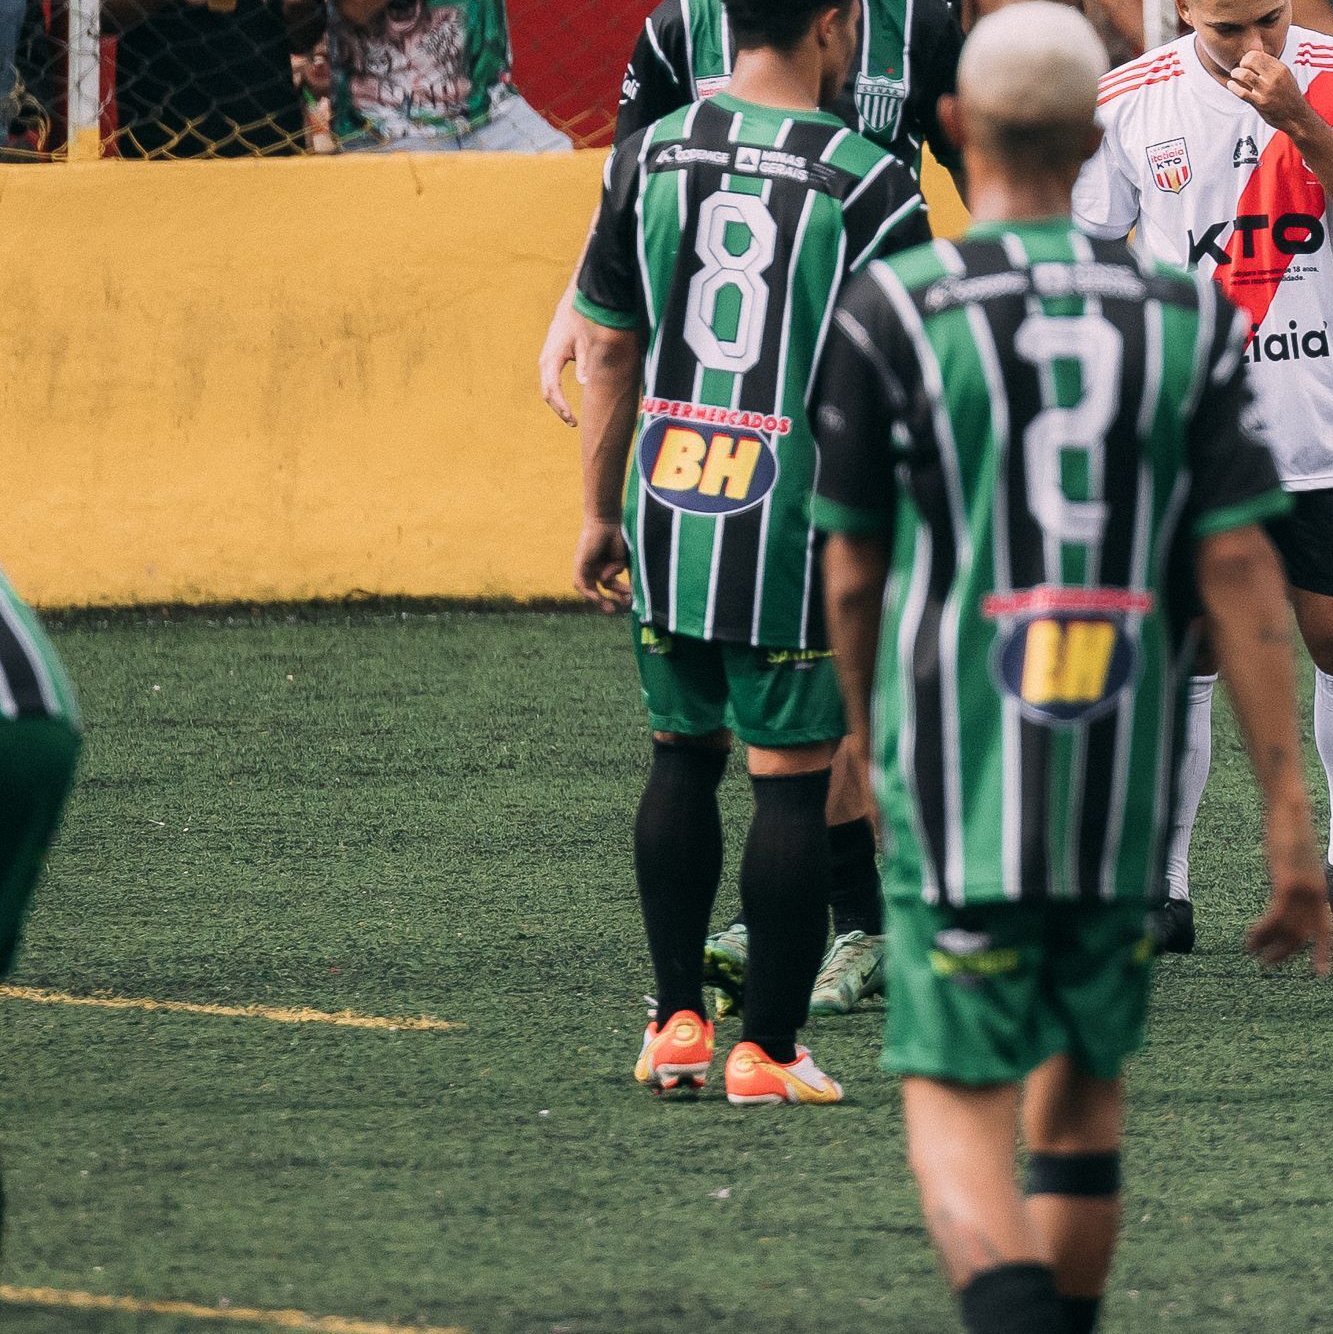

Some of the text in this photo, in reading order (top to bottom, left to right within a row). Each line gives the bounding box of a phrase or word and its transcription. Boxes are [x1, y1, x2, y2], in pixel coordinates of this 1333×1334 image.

[1151, 149, 1184, 164] itatiaia
[1156, 157, 1182, 170] KTO
[1187, 213, 1325, 270] KTO
[683, 190, 777, 374] 8
[1243, 320, 1330, 364] iaia
[641, 398, 791, 434] UPERMERCADOS
[1013, 316, 1124, 539] 2
[650, 426, 762, 500] BH
